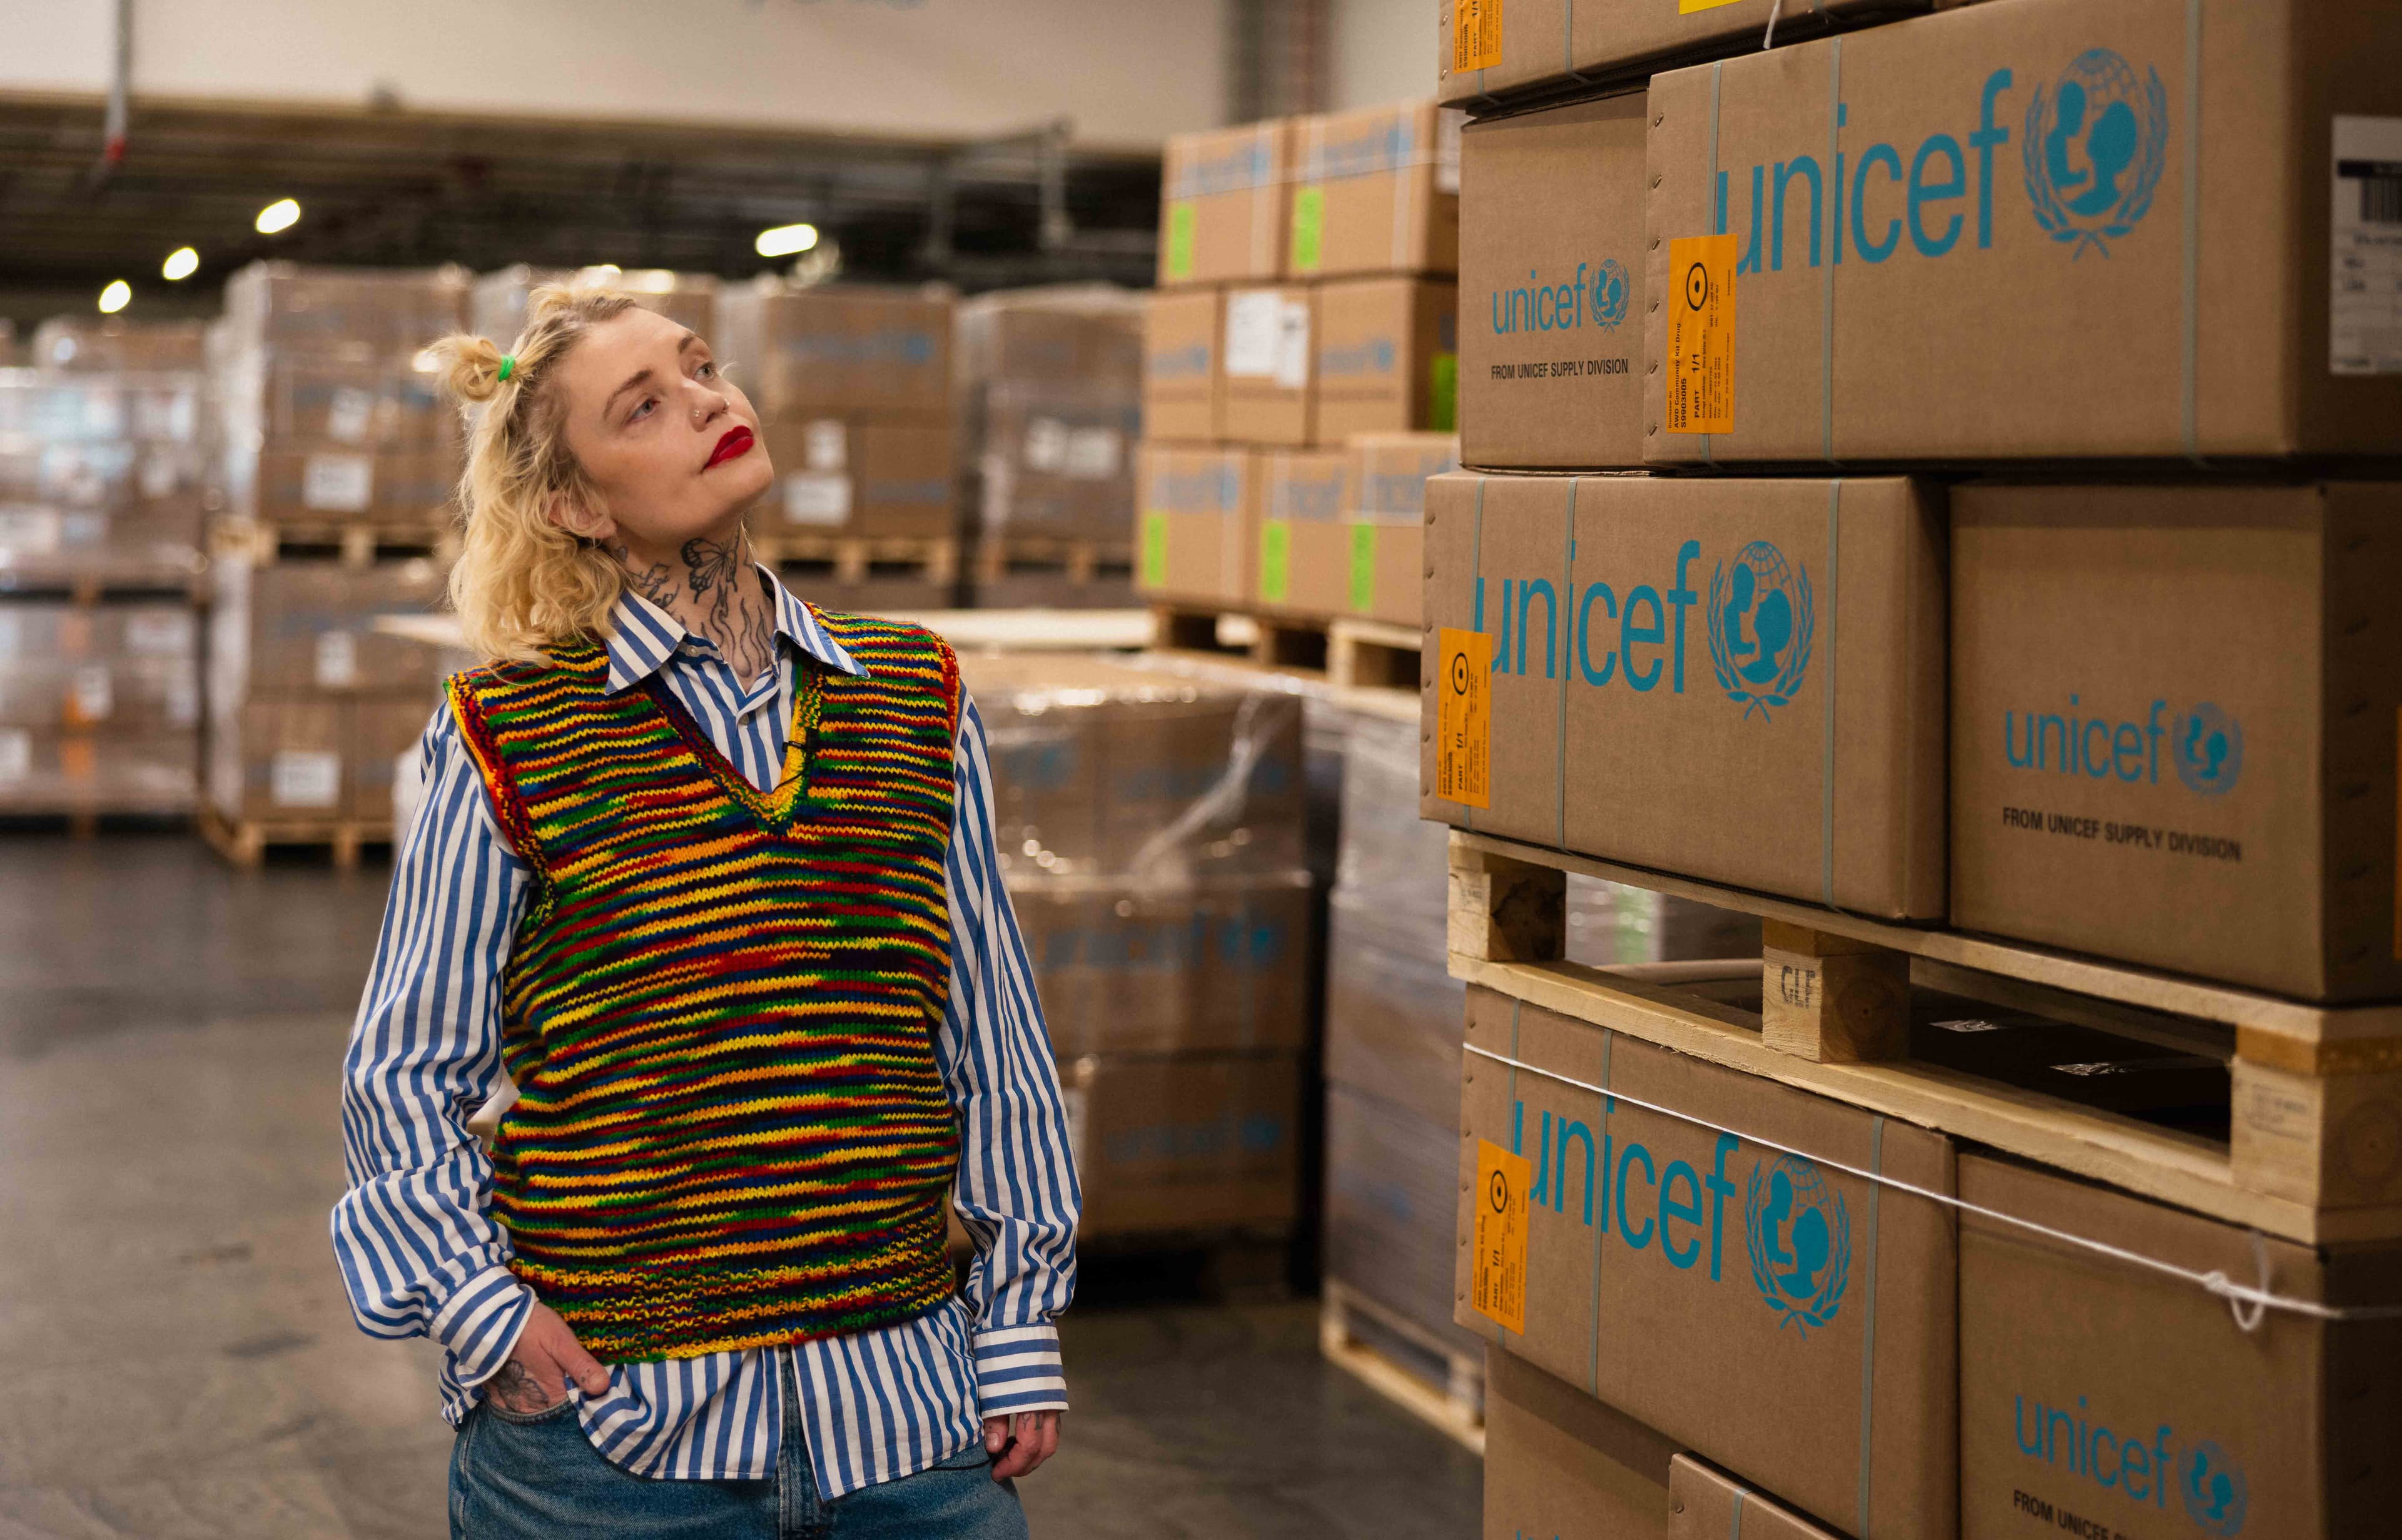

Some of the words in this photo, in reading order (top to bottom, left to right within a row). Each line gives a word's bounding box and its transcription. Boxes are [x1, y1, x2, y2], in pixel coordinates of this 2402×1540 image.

[1716, 68, 2012, 276] unicef
[1492, 262, 1587, 335] unicef
[1491, 365, 1515, 380] FROM
[1518, 363, 1548, 379] UNICEF
[1551, 360, 1584, 377] SUPPLY
[1588, 358, 1629, 375] DIVISION
[1691, 354, 1700, 373] 1/1
[1474, 540, 1701, 694] unicef
[2005, 693, 2167, 784] unicef
[2003, 807, 2043, 831] FROM
[2047, 814, 2100, 839] UNICEF
[2105, 822, 2163, 849] SUPPLY
[2168, 831, 2242, 861] DIVISION
[1513, 1094, 1740, 1282] unicef
[2015, 1395, 2172, 1508] unicef
[2014, 1489, 2054, 1522] FROM
